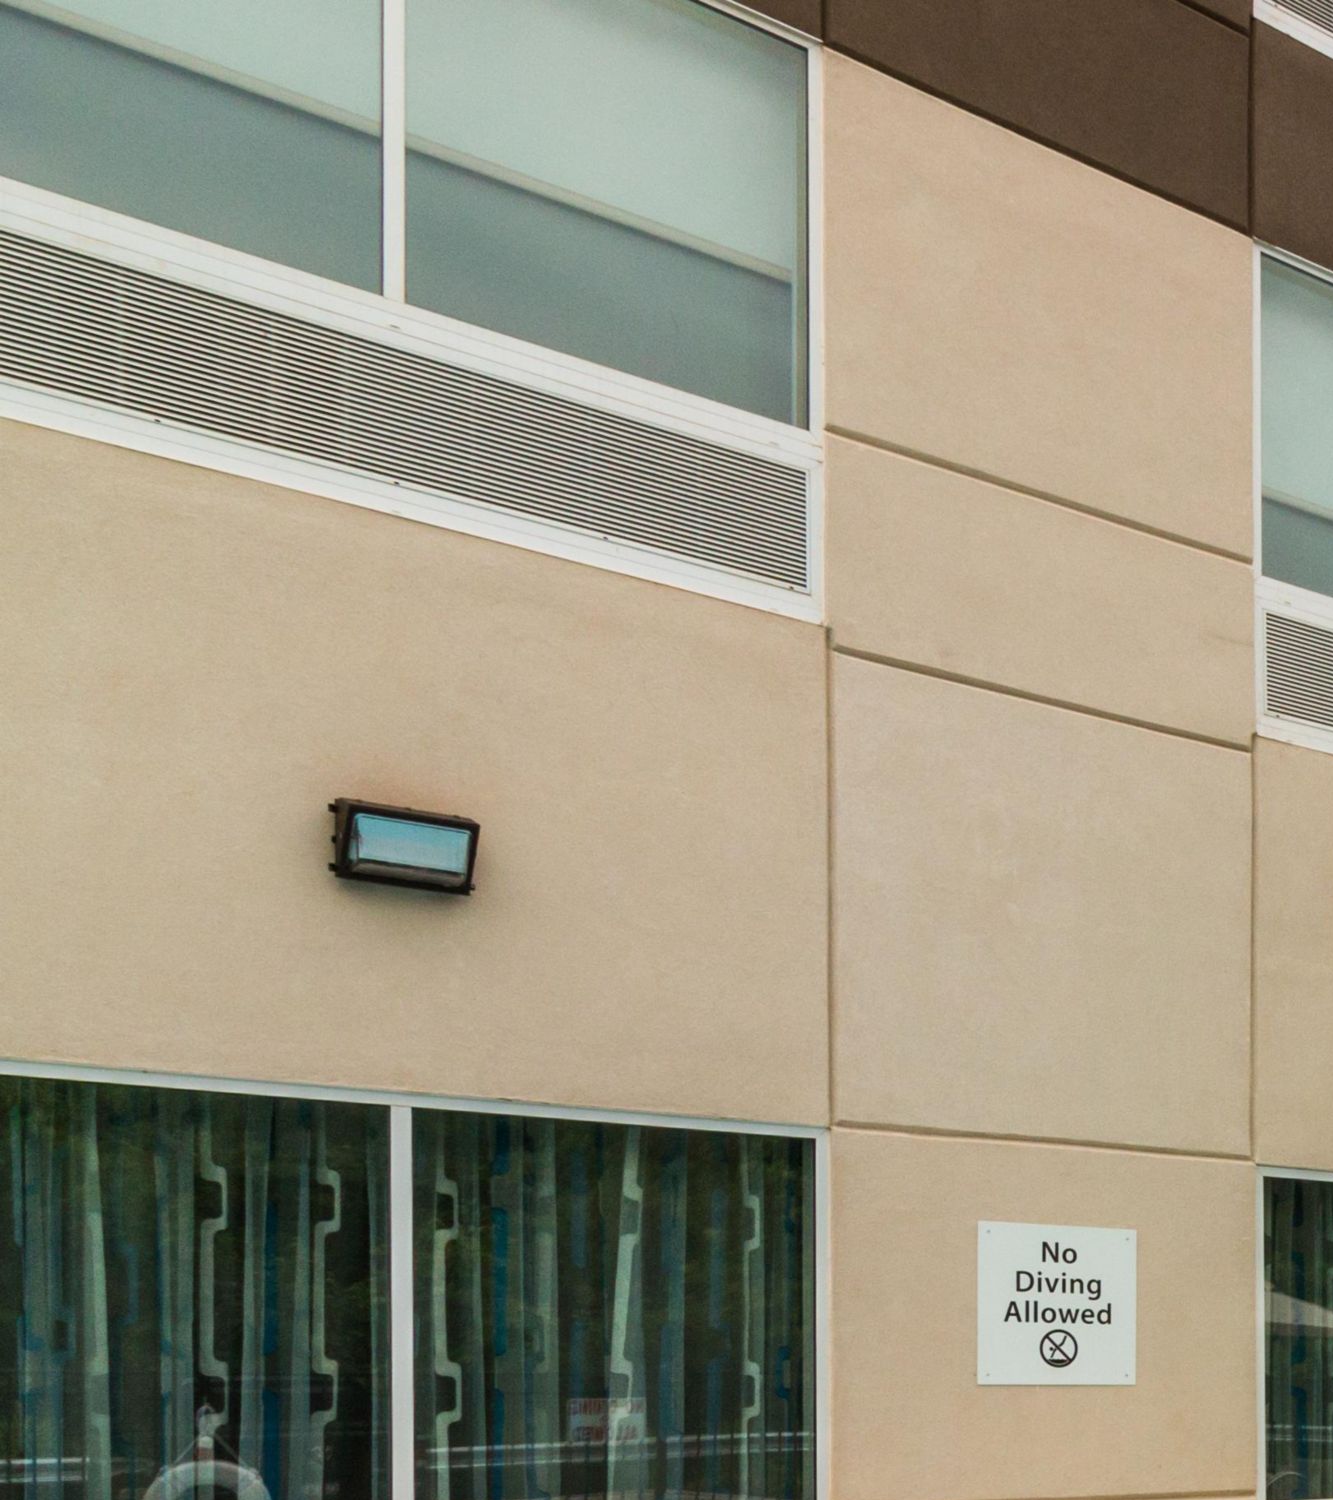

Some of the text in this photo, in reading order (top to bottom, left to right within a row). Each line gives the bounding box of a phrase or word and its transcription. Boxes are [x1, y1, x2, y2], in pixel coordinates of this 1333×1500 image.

[1041, 1241, 1078, 1265] No
[1015, 1270, 1102, 1300] Diving
[1004, 1300, 1112, 1325] Allowed
